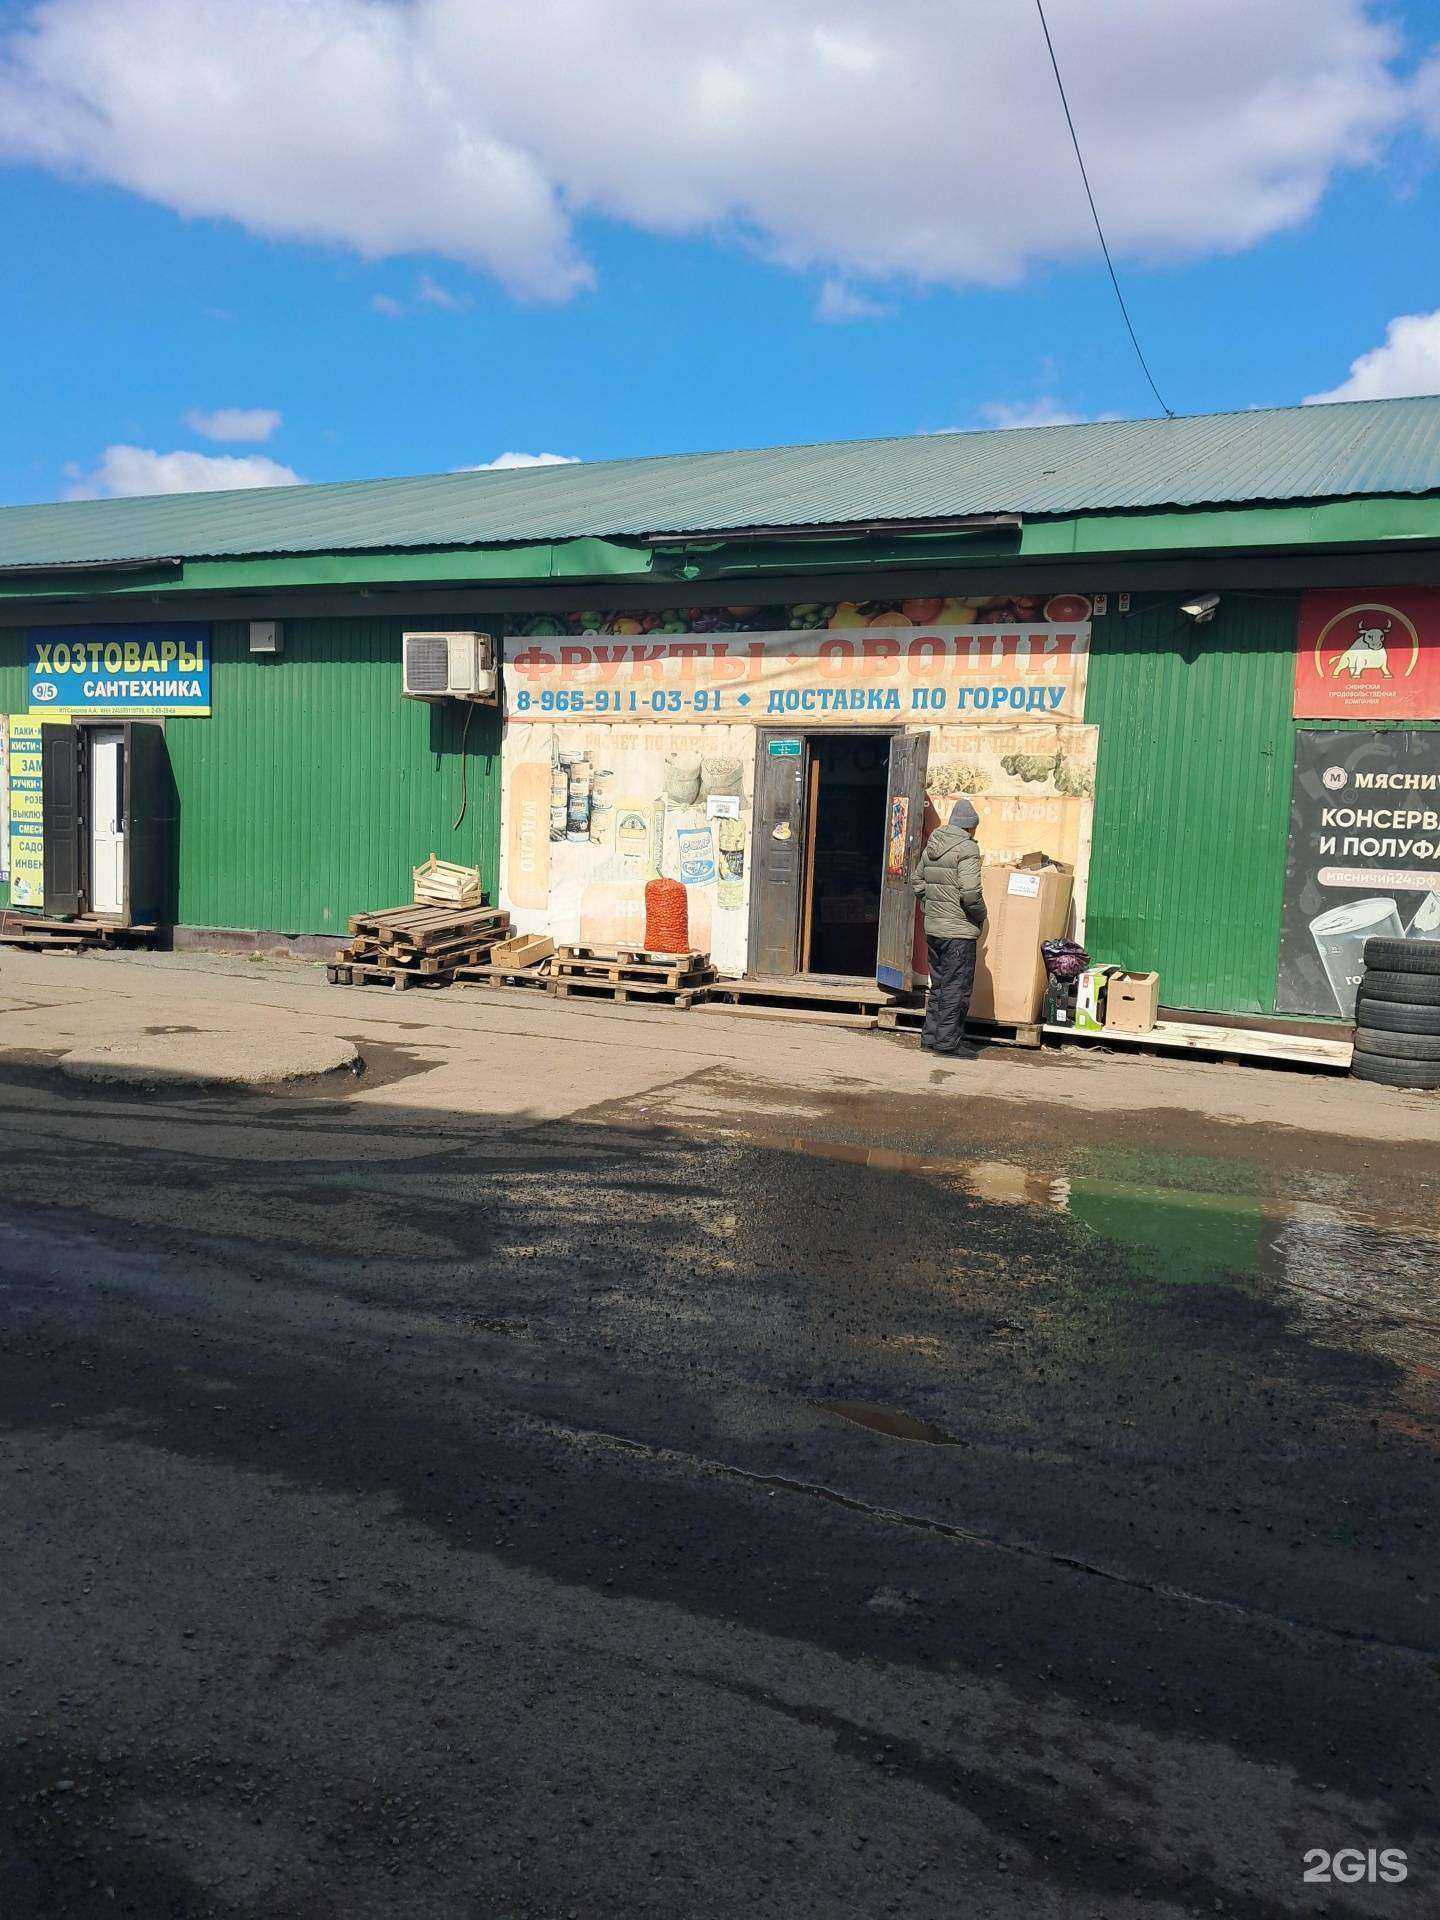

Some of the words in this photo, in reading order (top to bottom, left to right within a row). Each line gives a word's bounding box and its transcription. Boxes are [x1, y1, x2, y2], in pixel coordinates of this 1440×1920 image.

[35, 640, 204, 674] ХОЗТОВАРЫ
[513, 642, 765, 681] ФРУКТЫ
[818, 634, 1077, 679] ОВОЩИ
[36, 685, 54, 697] 9/5
[83, 680, 203, 697] САНТЕХНИКА
[517, 689, 721, 712] 8-965-911-03-91
[767, 688, 900, 713] ДОСТАВКА
[912, 687, 946, 710] ПО
[958, 686, 1066, 712] ГОРОДУ
[14, 727, 33, 736] ЛАКИ
[11, 741, 36, 751] КИСТИ
[12, 779, 36, 789] РУЧКИ
[1330, 773, 1341, 782] М
[1355, 773, 1440, 790] МЯСНИ
[1321, 808, 1440, 831] КОНСЕРВ
[19, 841, 43, 853] САДО
[1320, 836, 1336, 855] И
